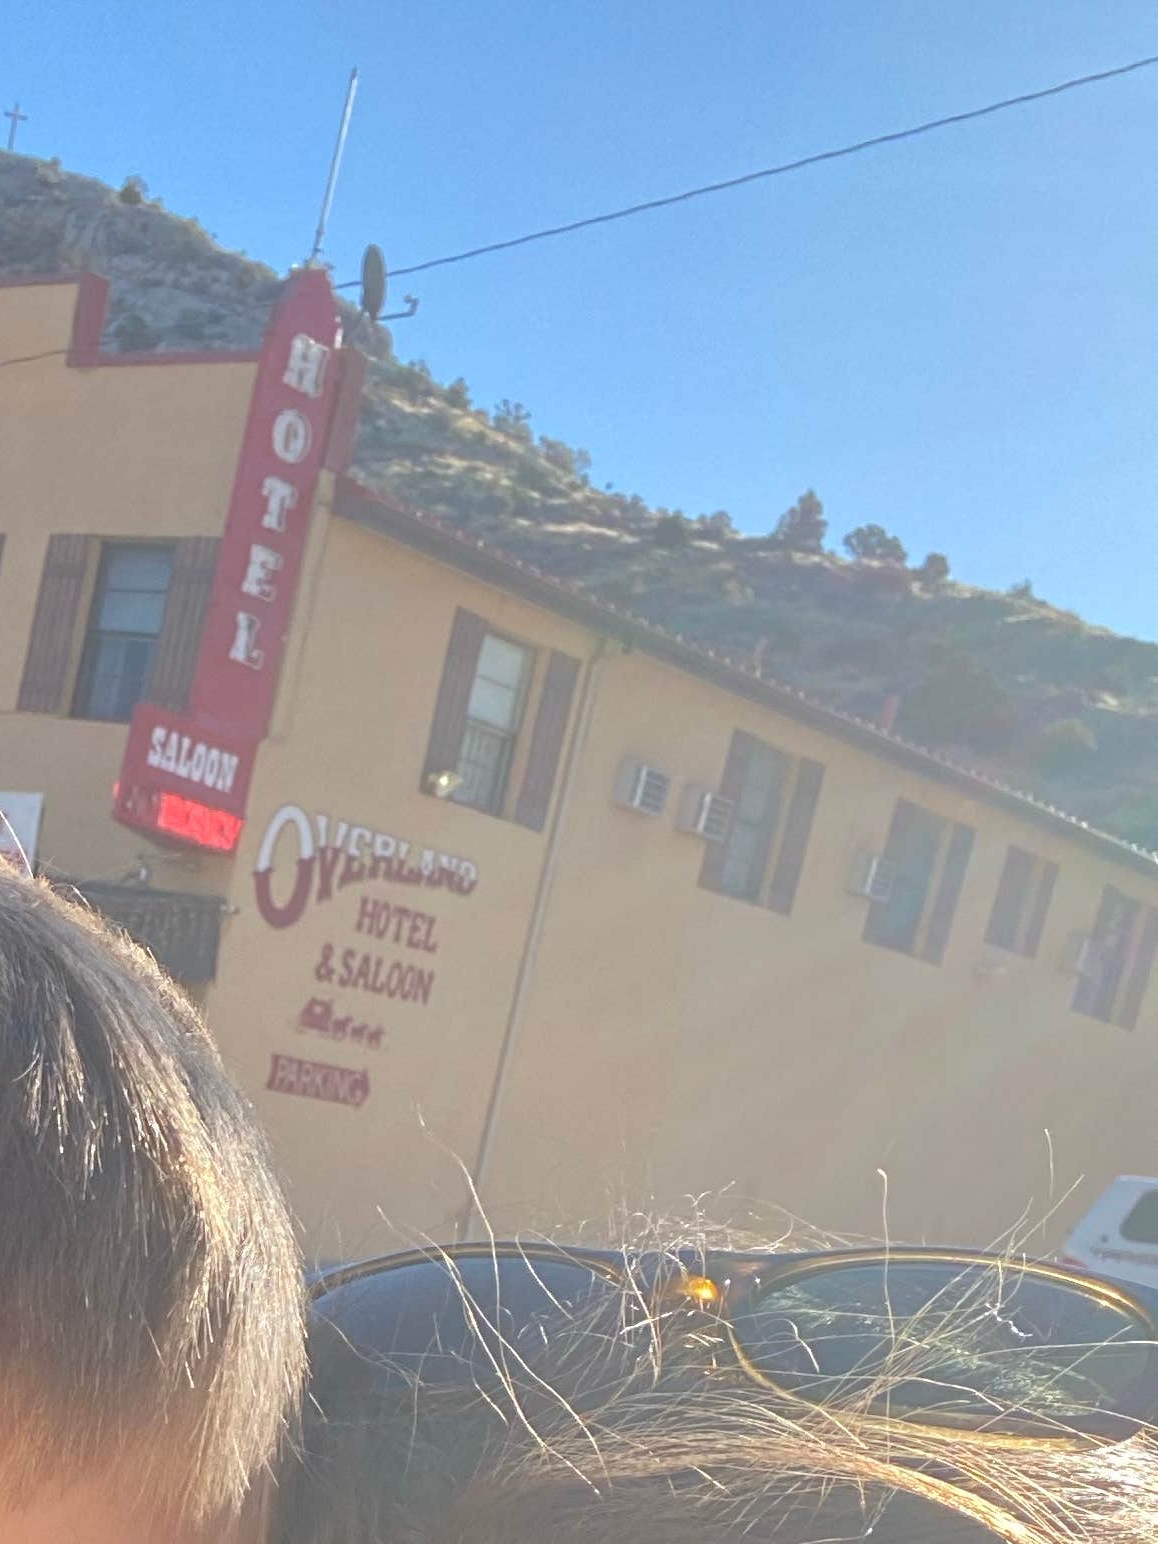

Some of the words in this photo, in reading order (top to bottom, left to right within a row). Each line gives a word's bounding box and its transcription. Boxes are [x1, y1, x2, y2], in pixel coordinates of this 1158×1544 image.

[228, 332, 331, 670] HOTEL
[146, 725, 240, 793] SALOON
[253, 805, 479, 930] OVERLAND
[355, 896, 438, 954] HOTEL
[314, 942, 336, 984] &
[337, 948, 435, 1005] SALOON
